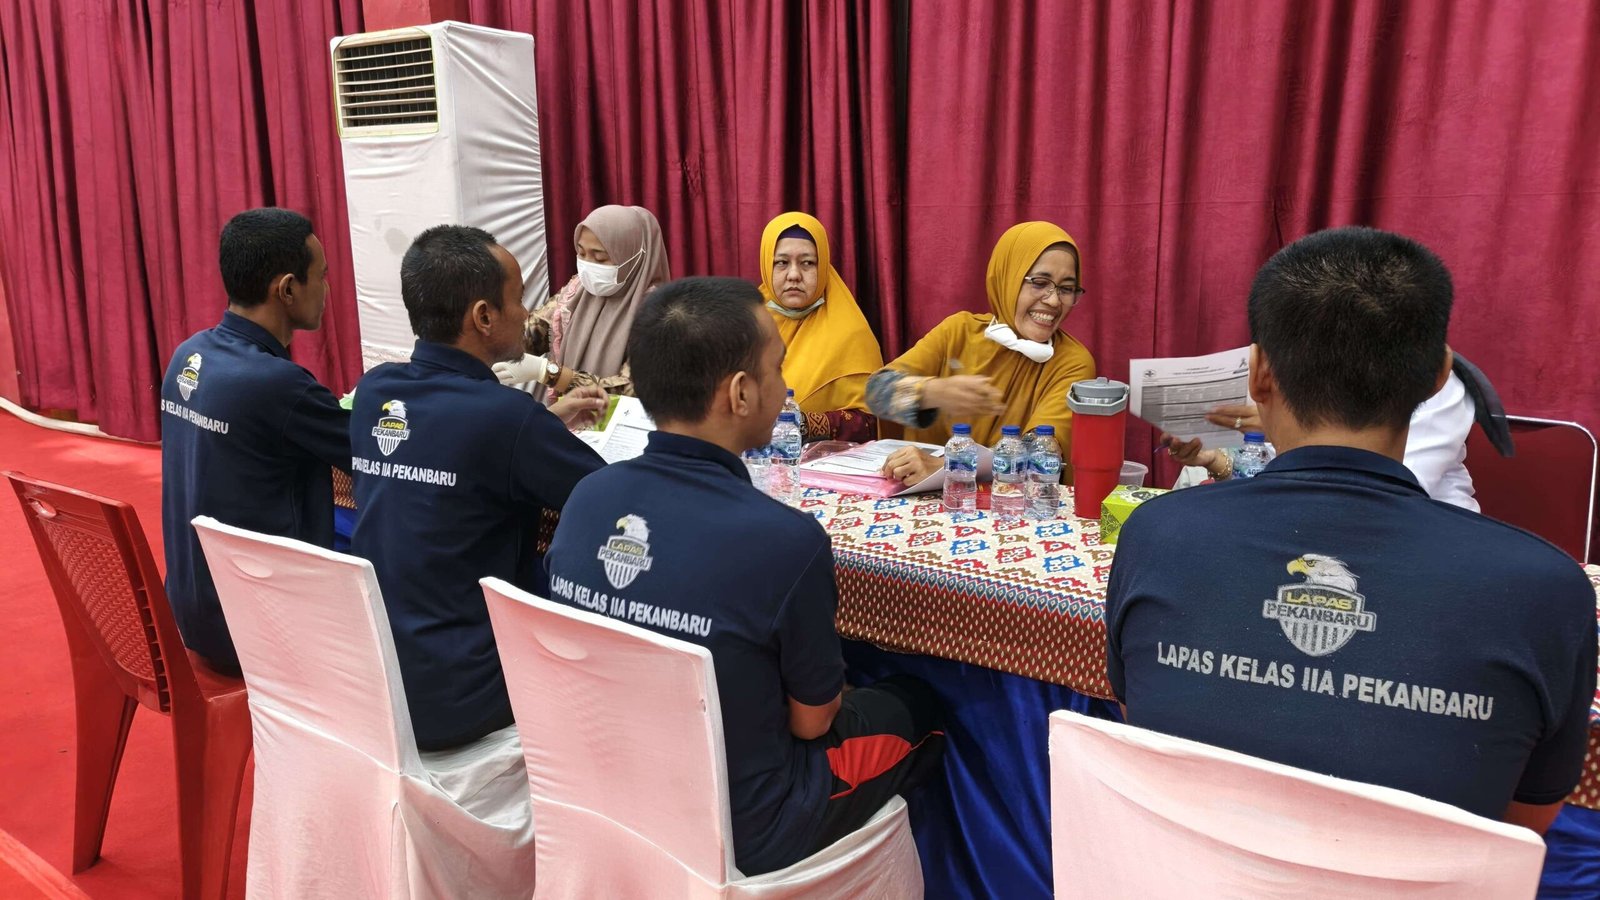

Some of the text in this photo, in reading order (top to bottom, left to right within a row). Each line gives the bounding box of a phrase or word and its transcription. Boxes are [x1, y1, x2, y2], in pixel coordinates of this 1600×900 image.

[189, 409, 229, 434] PEKANBARU
[381, 420, 404, 430] LAPAS
[373, 428, 408, 439] PEKANBARU
[381, 462, 391, 477] IIA
[392, 464, 457, 487] PEKANBARU
[600, 549, 649, 568] PEKANBARU
[611, 540, 644, 555] LAPAS
[551, 574, 712, 637] LAPAS KELAS IIA PEKANBARU
[1286, 591, 1353, 610] LAPAS
[1266, 602, 1371, 629] PEKANBARU
[1157, 642, 1494, 721] LAPAS KELAS IIA PEKANBARU
